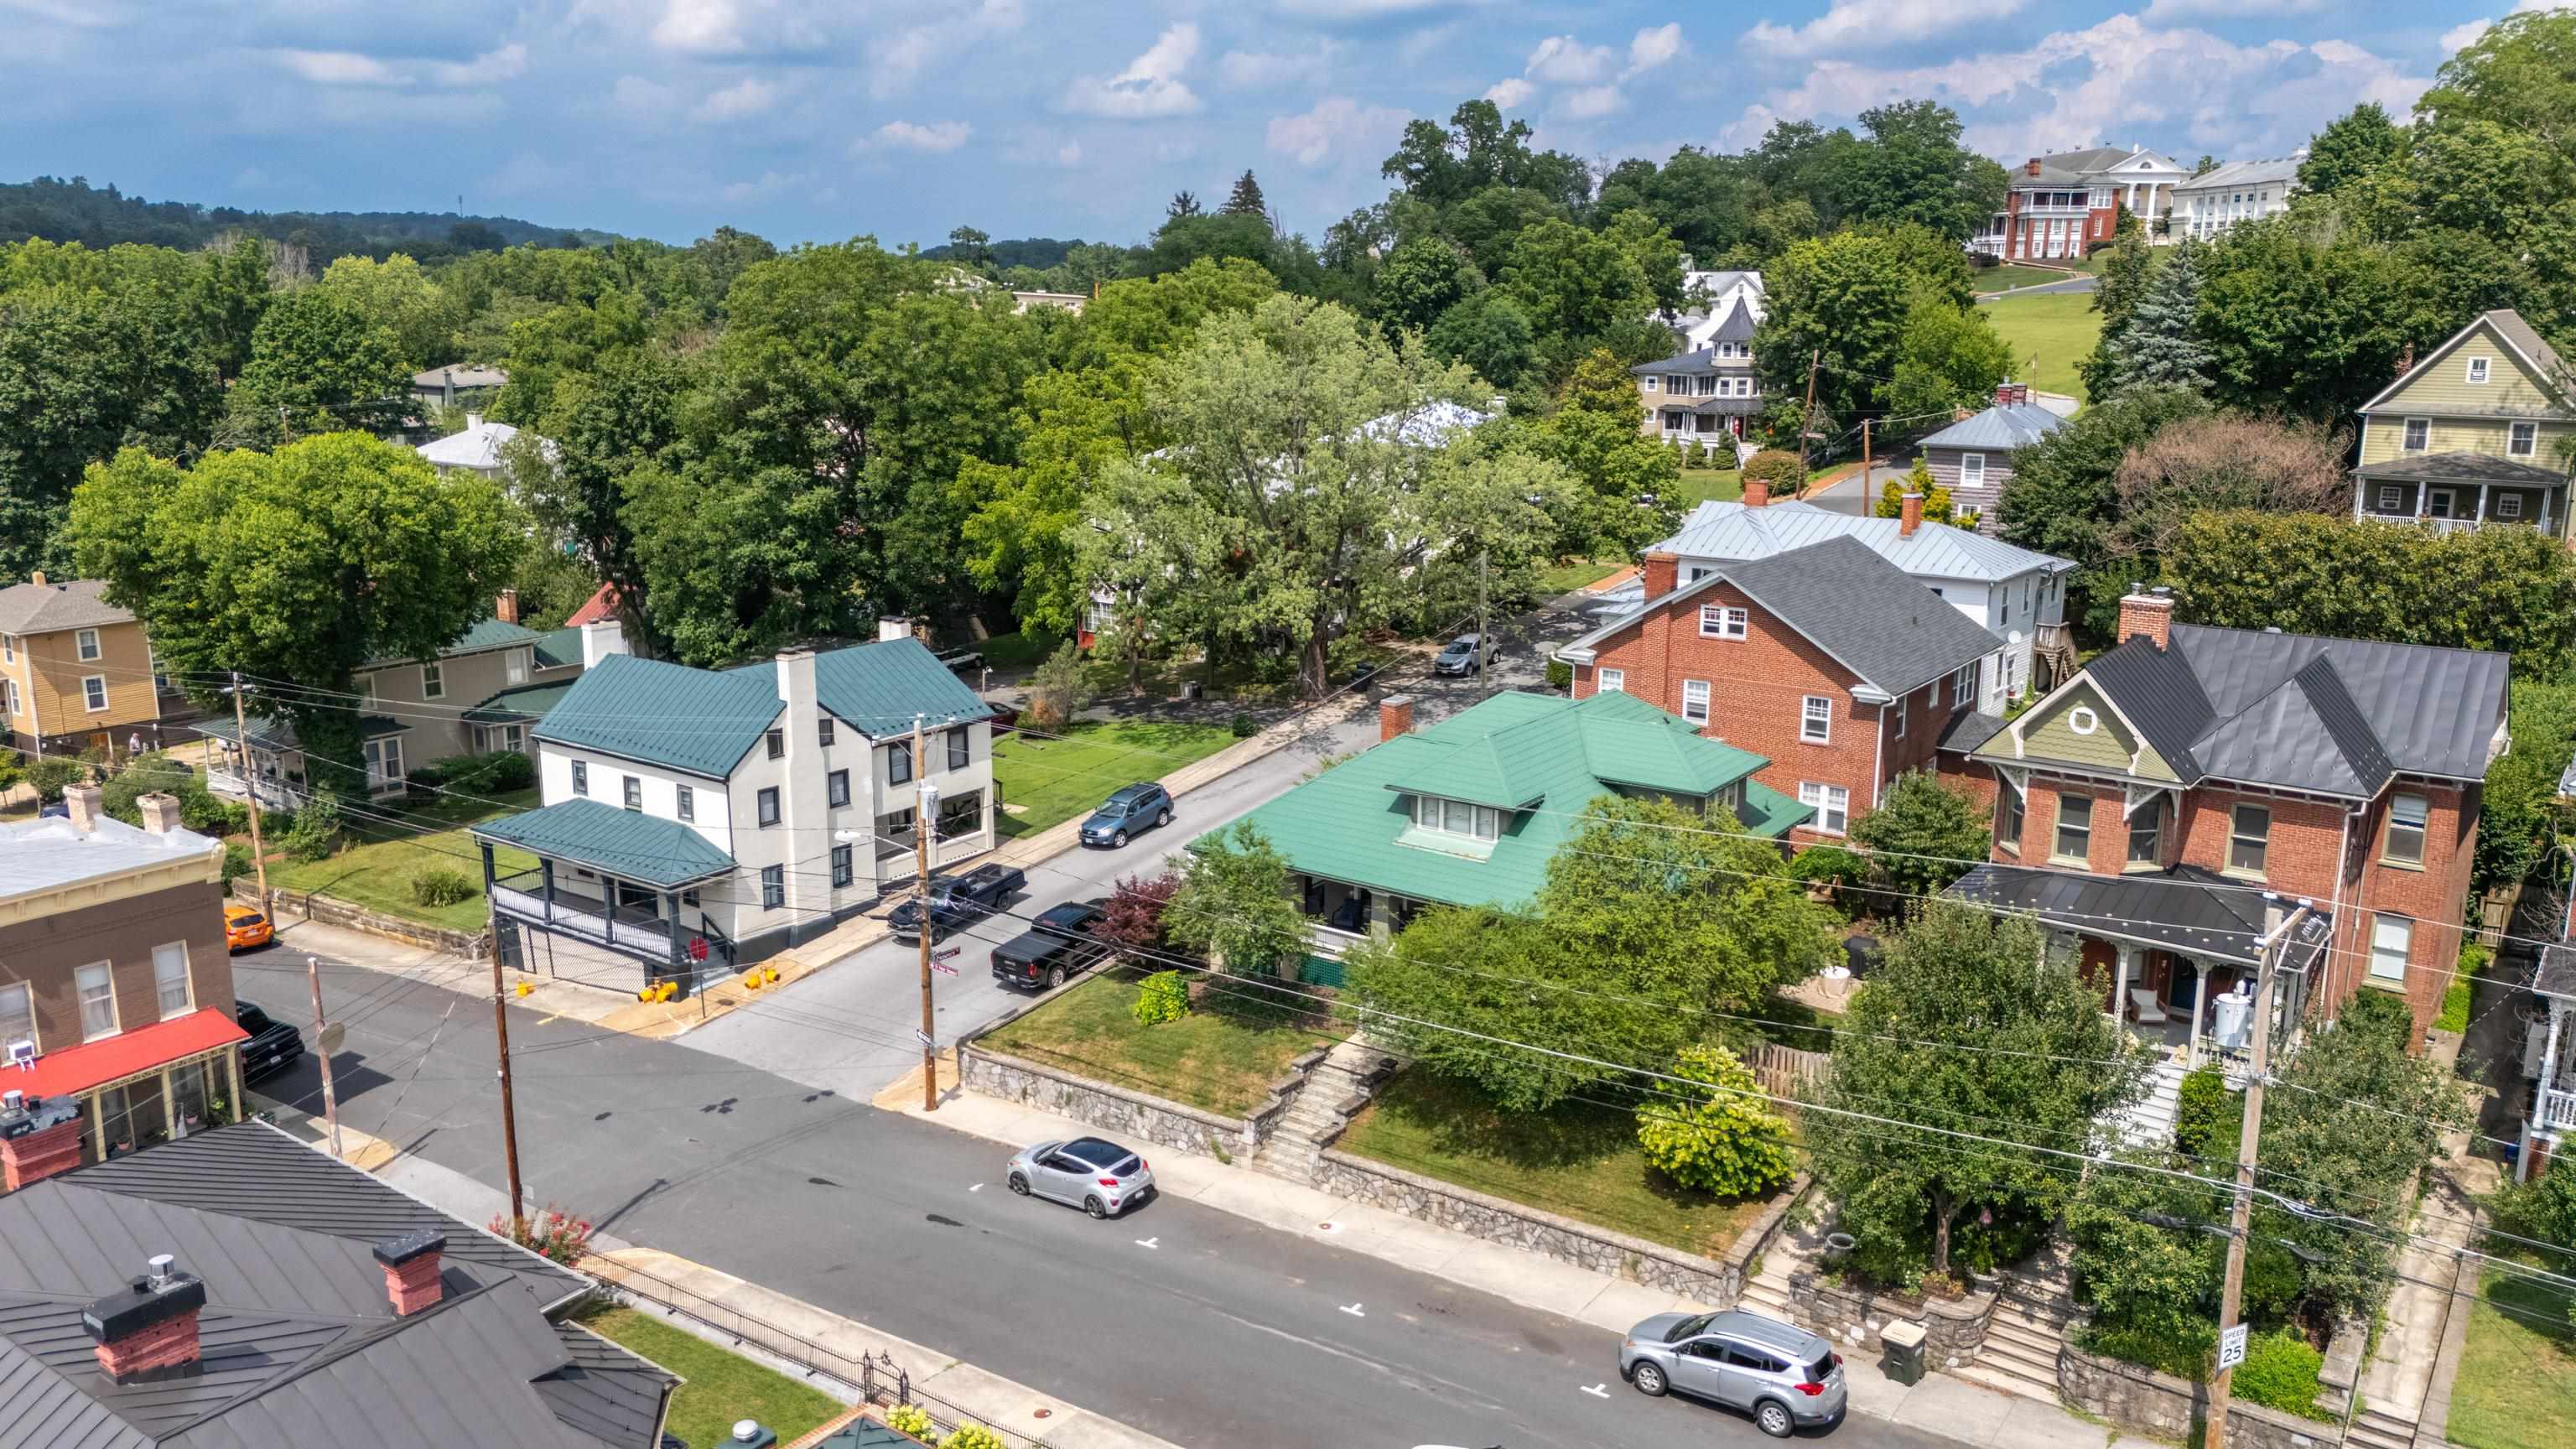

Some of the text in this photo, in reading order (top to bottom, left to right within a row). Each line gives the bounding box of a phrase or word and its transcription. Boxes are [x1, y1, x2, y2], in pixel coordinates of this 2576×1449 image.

[2224, 1328, 2245, 1339] SPEED
[2225, 1337, 2241, 1348] LIMIT
[2223, 1345, 2241, 1363] 25
